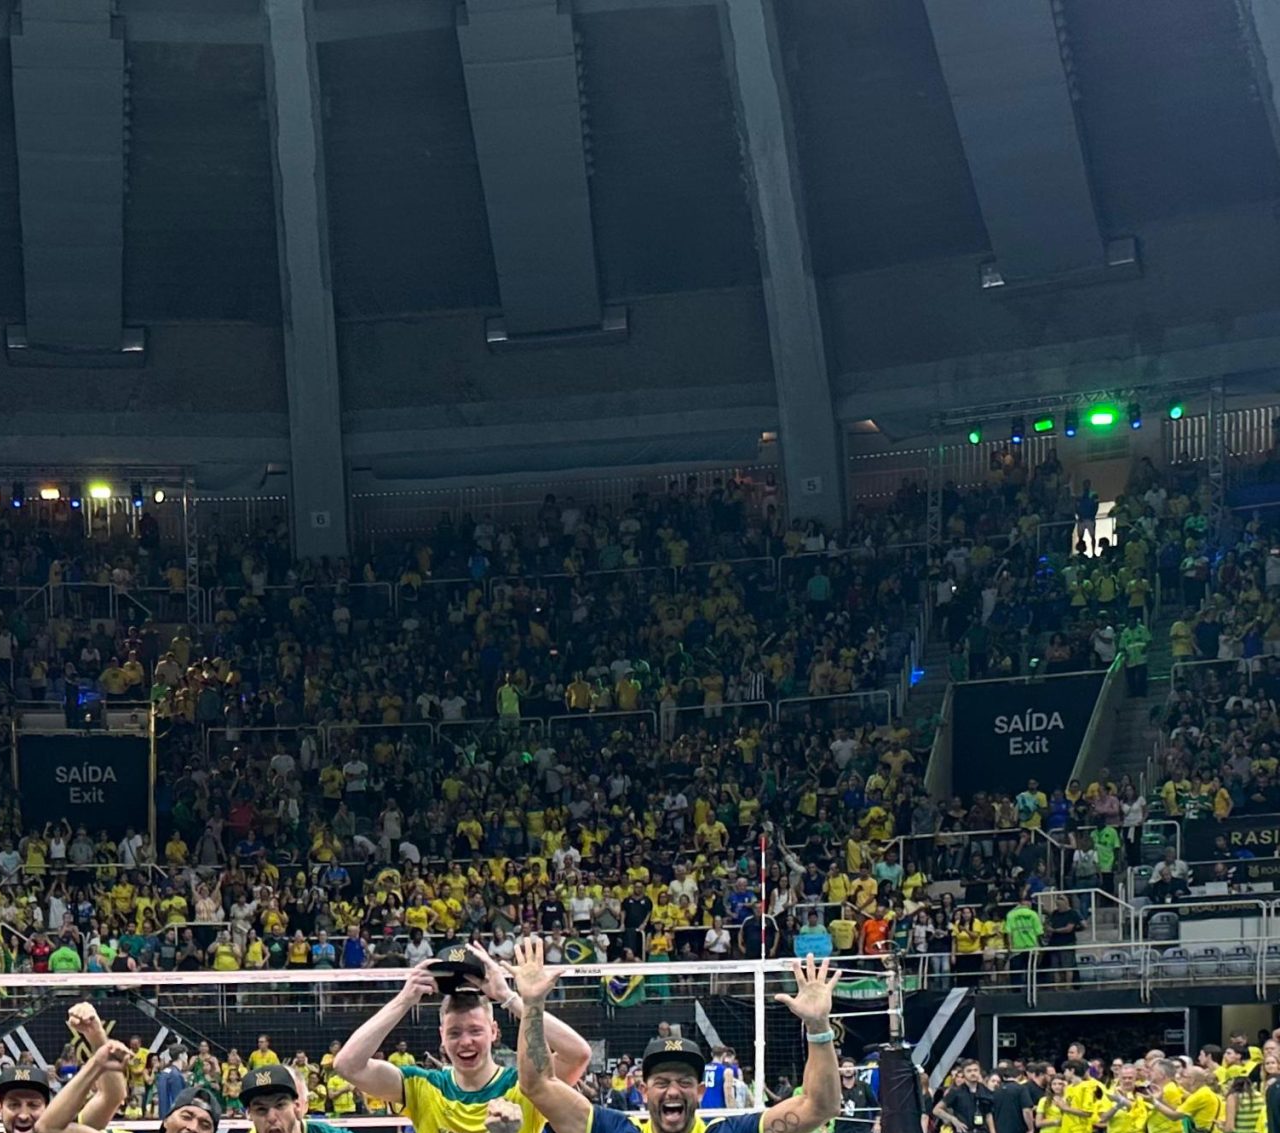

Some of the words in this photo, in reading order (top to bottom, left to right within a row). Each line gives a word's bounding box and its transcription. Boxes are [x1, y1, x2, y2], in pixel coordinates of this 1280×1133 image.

[807, 480, 817, 492] 5
[316, 514, 325, 525] 6
[994, 708, 1065, 734] SAÍDA
[1009, 736, 1049, 755] Exit
[55, 762, 117, 784] SAÍDA
[69, 786, 104, 804] Exit
